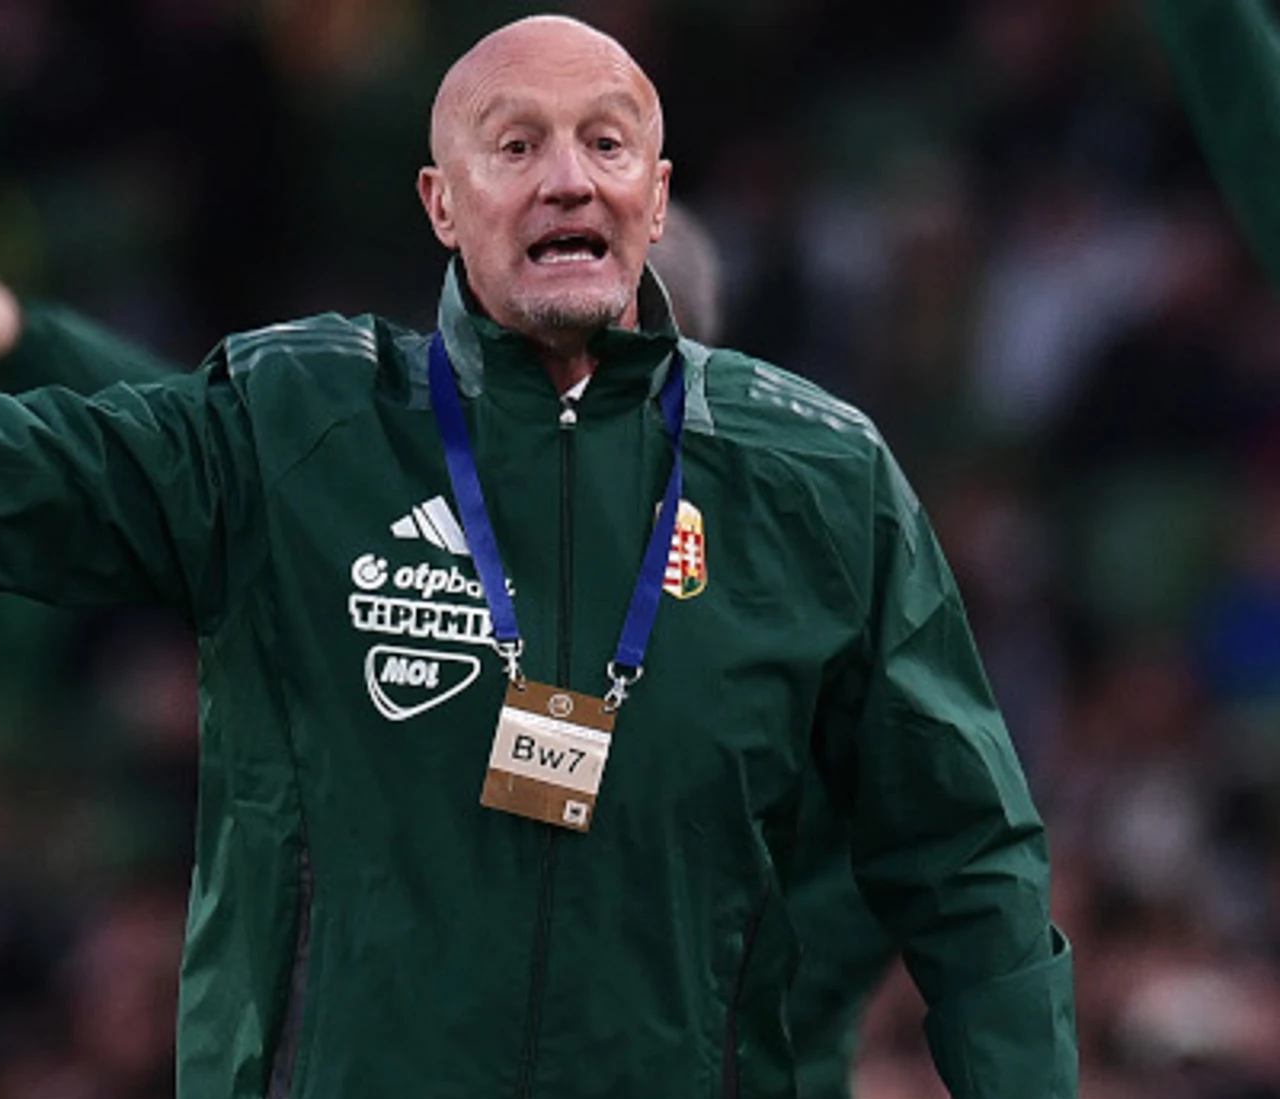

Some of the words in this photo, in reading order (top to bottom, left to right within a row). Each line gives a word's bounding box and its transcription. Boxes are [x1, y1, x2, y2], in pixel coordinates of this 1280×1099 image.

[393, 562, 516, 599] otpba
[353, 599, 495, 638] TiPPMI
[380, 656, 440, 688] MOL
[512, 734, 587, 774] Bw7
